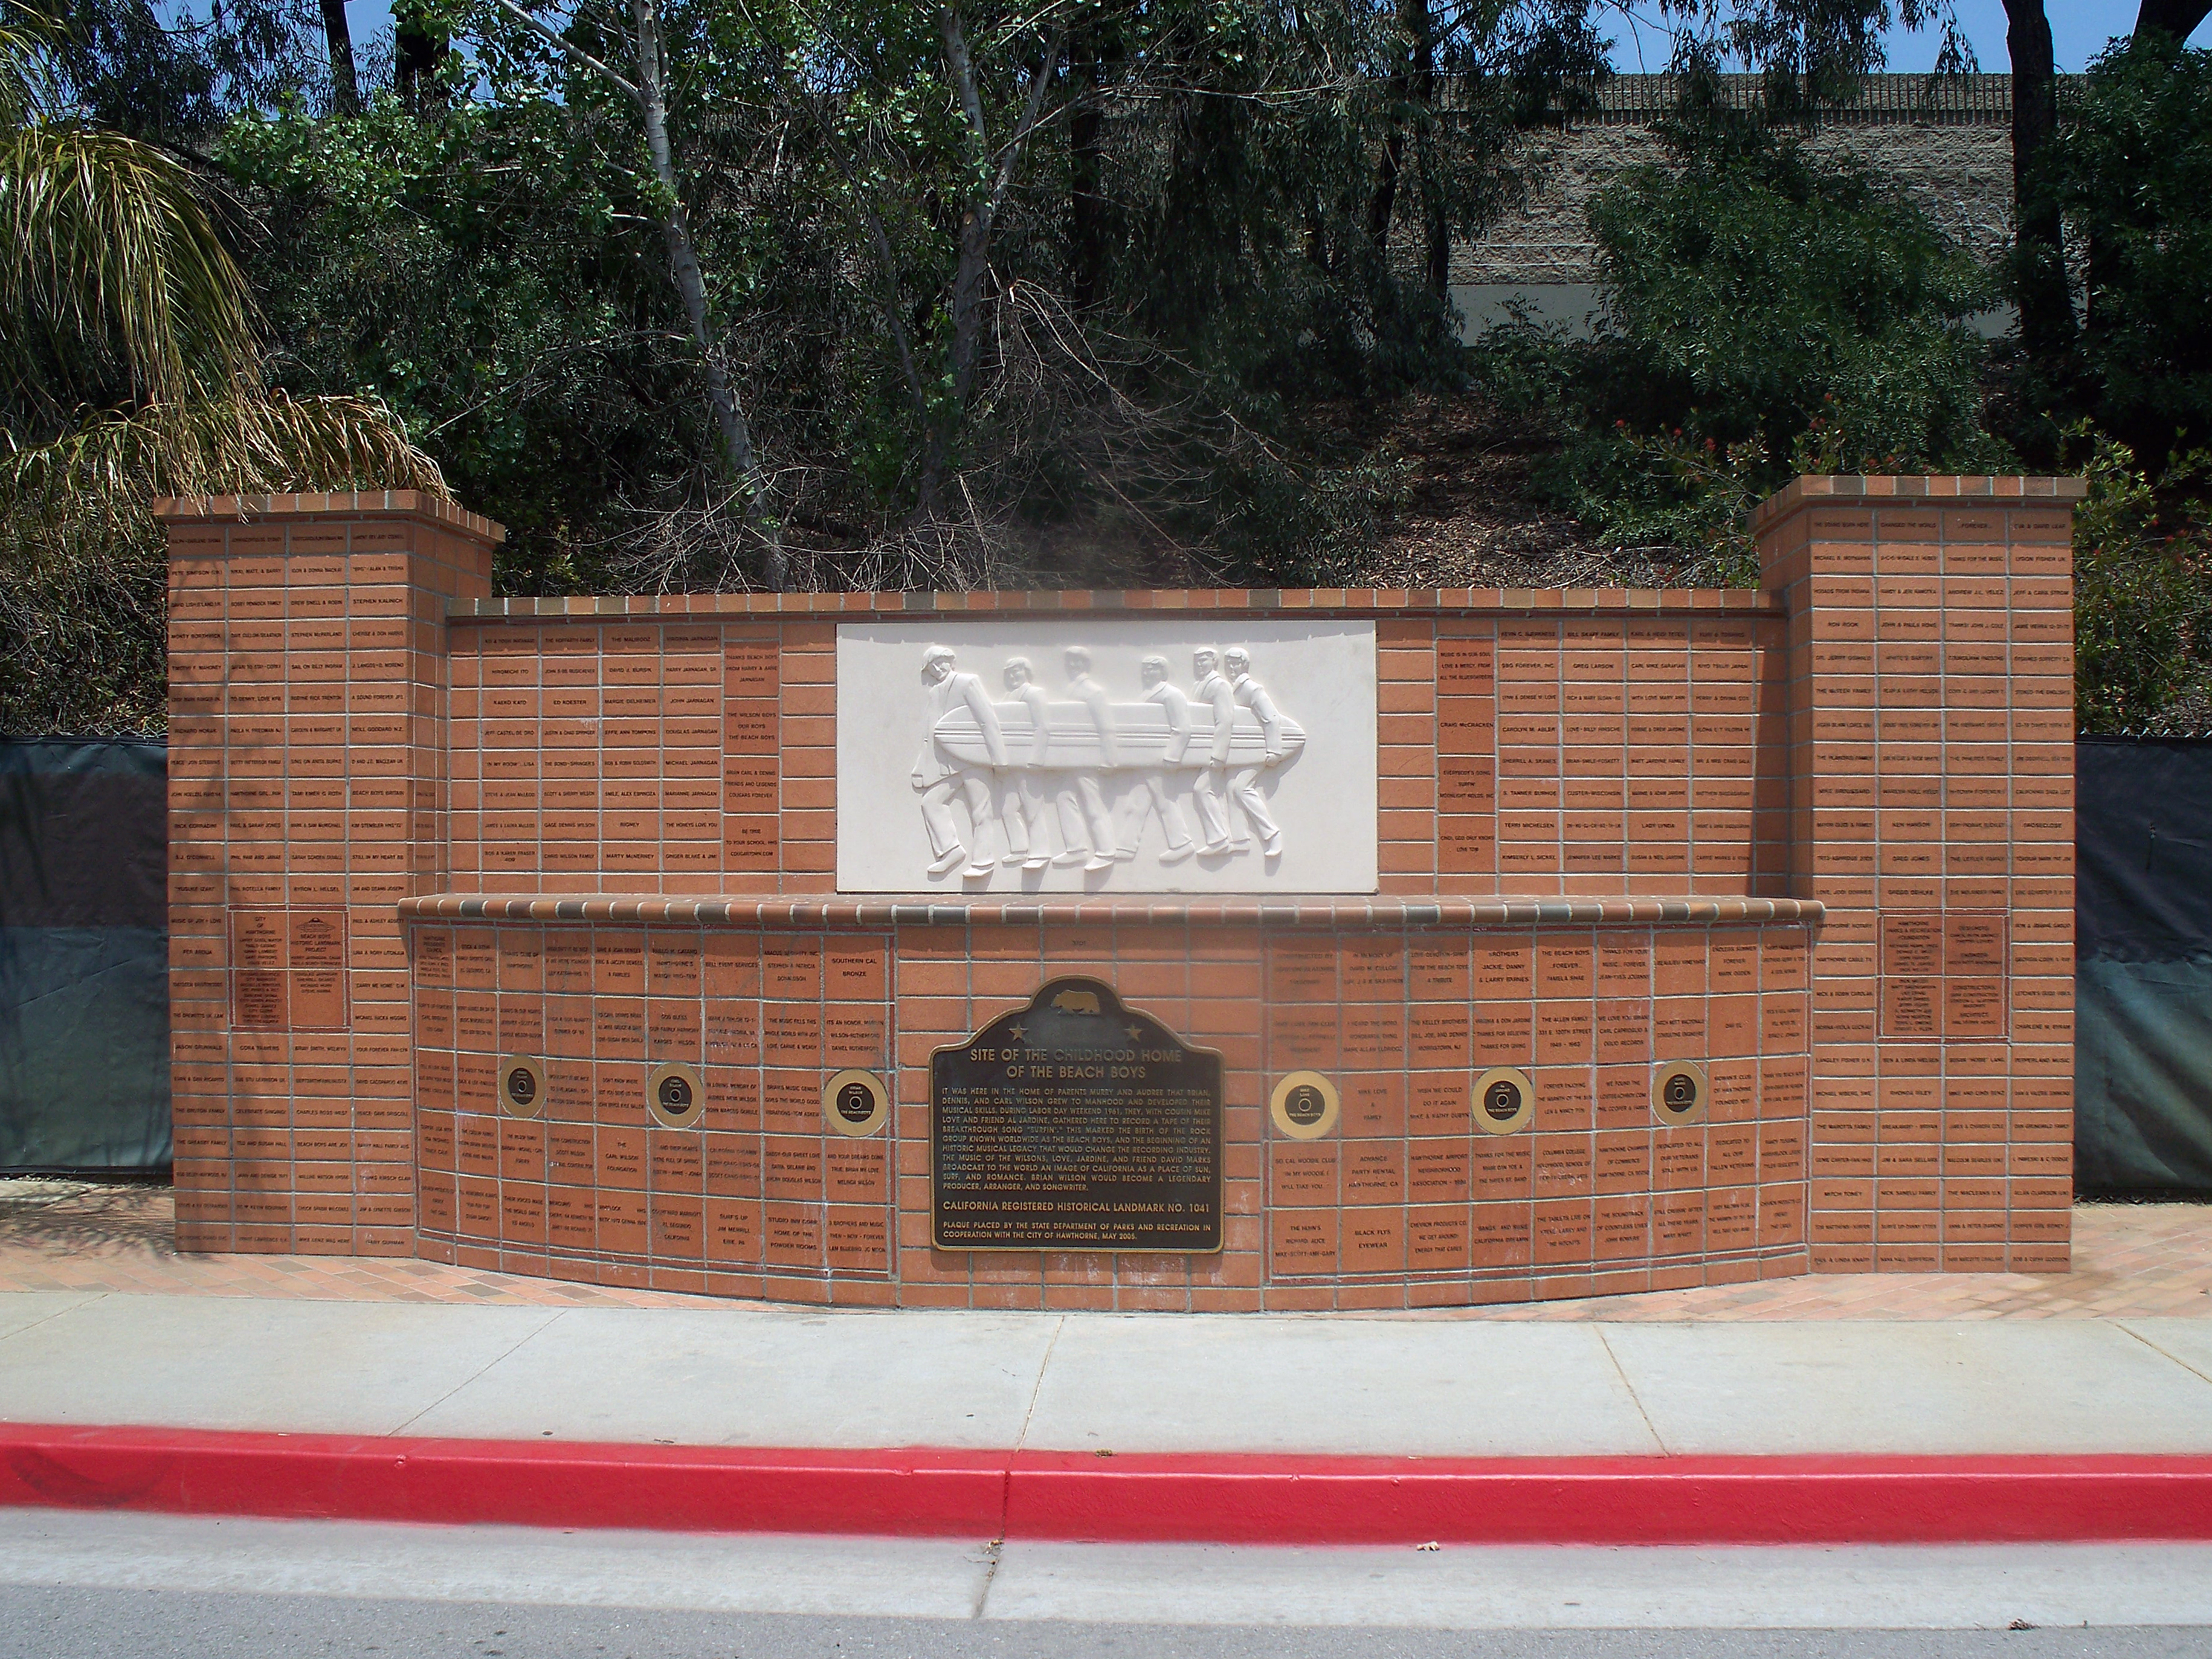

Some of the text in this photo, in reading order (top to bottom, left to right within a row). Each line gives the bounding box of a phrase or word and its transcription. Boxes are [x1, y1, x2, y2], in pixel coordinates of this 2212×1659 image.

[970, 1049, 1181, 1062] SITE OF THE CHILDHOOD HOME
[1006, 1065, 1146, 1078] OF THE BEACH BOYS
[943, 1202, 1210, 1213] CALIFORNIA REGISTERED HISTORICAL LANDMARK NO. 1041
